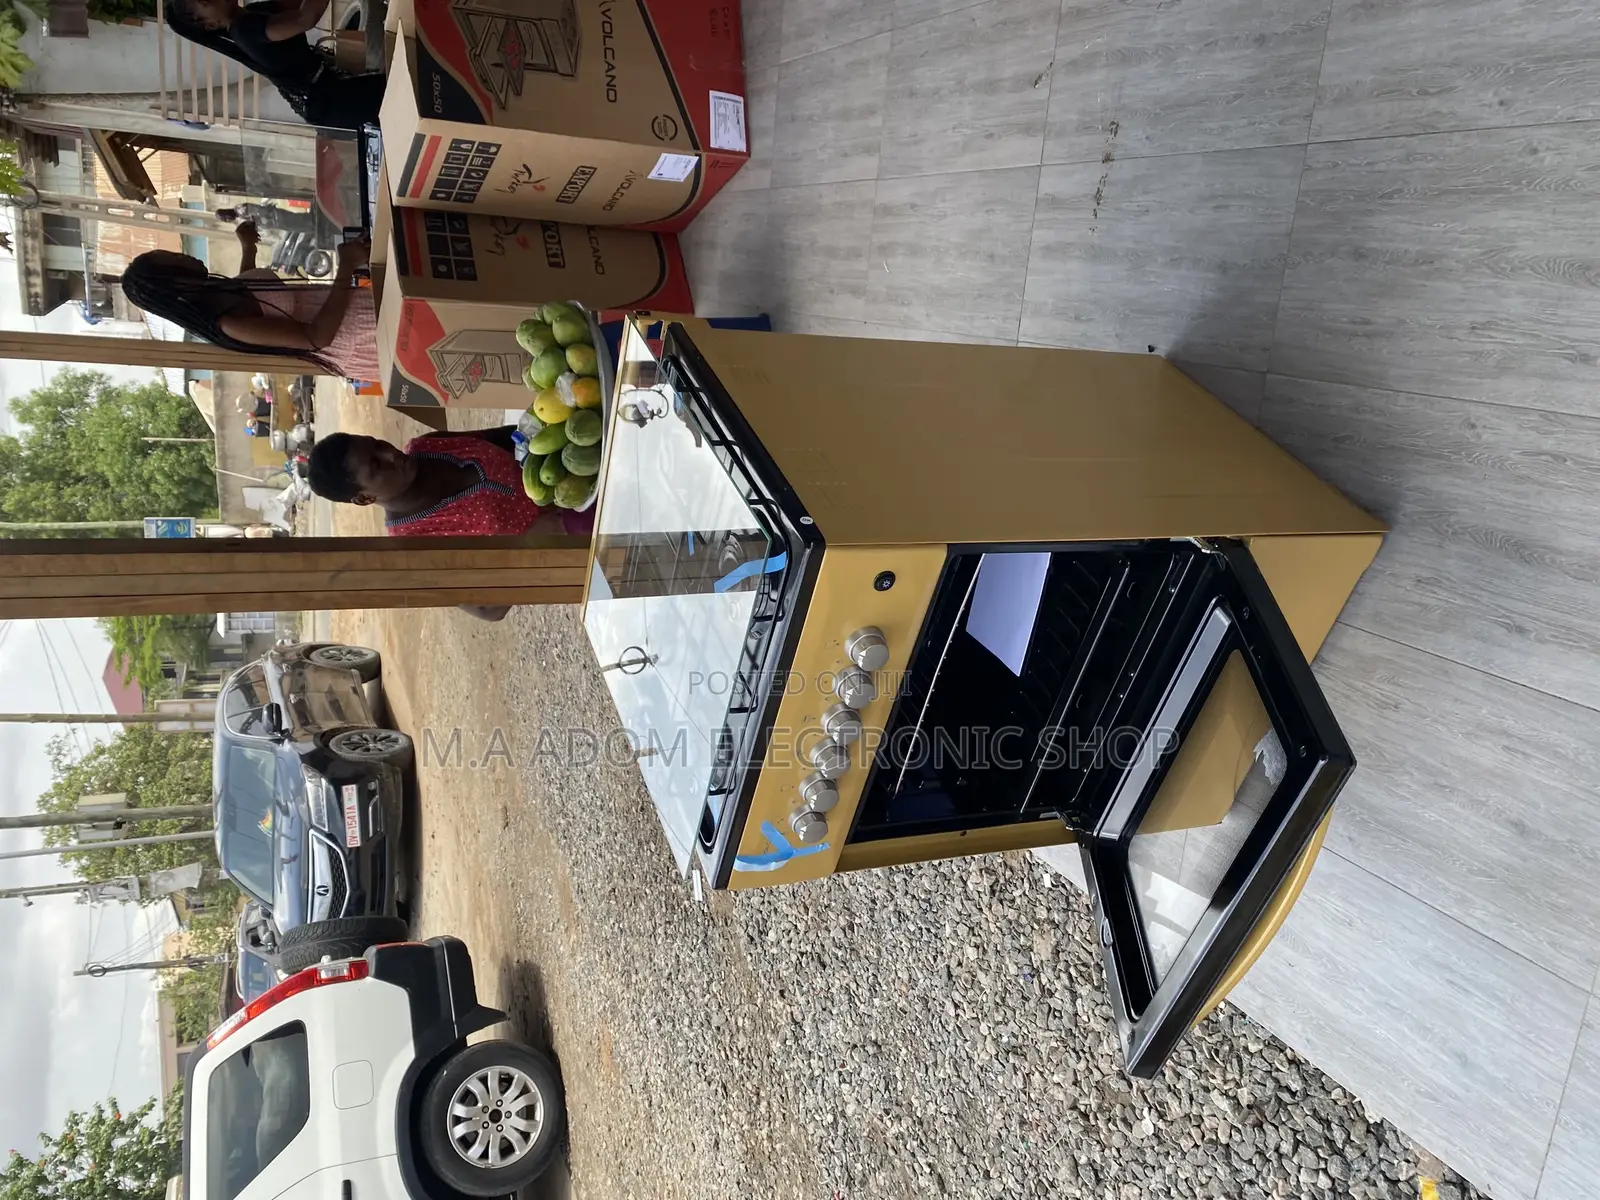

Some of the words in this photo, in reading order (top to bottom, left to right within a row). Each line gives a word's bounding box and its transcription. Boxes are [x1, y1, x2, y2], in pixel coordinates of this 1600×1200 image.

[601, 8, 618, 103] VOLCANO
[557, 166, 596, 203] EXPORT
[602, 171, 635, 211] VOLCANO
[541, 221, 565, 267] PORT
